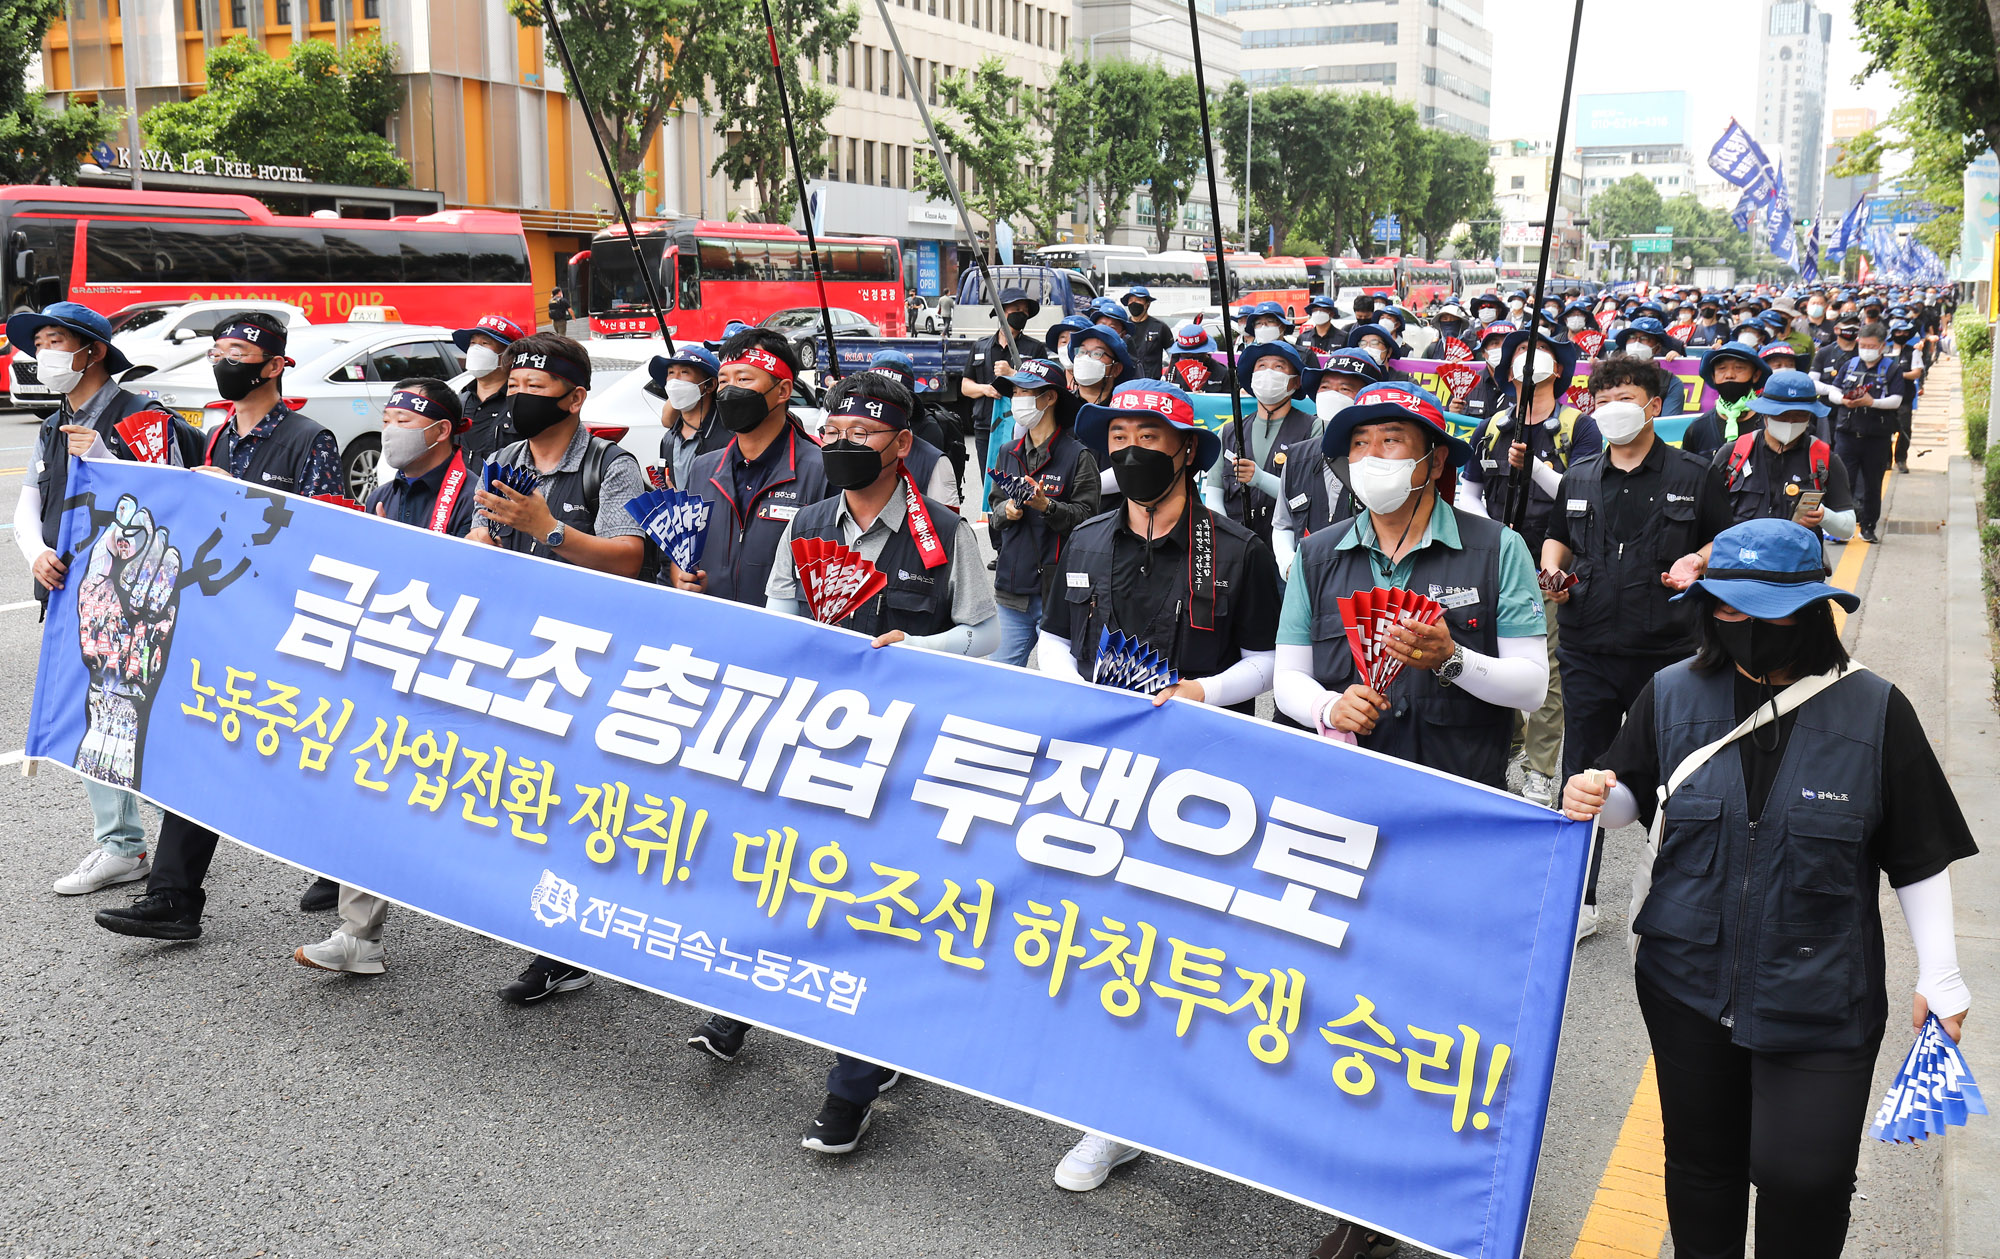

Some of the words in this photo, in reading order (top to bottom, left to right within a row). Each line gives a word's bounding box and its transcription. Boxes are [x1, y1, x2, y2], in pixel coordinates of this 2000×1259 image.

[117, 147, 175, 172] KAYA
[182, 152, 206, 175] La
[257, 165, 307, 182] HOTEL
[938, 212, 947, 220] Auto
[920, 269, 936, 278] GRAND
[920, 279, 936, 289] OPEN
[353, 312, 377, 321] TAXI
[746, 349, 777, 371] 투쟁
[844, 352, 864, 362] KIA
[838, 397, 883, 419] 파업
[1143, 394, 1173, 414] 투쟁
[275, 553, 613, 738] 금속노조
[595, 644, 915, 819] 총파업
[911, 714, 1380, 949] 투쟁으로
[1817, 791, 1849, 802] 금속노조
[180, 659, 355, 772] 노동중심
[350, 715, 562, 845] 산업전환
[569, 781, 708, 885] 쟁취!
[732, 826, 995, 970] 대우조선
[1013, 899, 1307, 1065] 하청투쟁
[1319, 994, 1511, 1133] 승리!
[577, 896, 868, 1016] 전국금속노동조합
